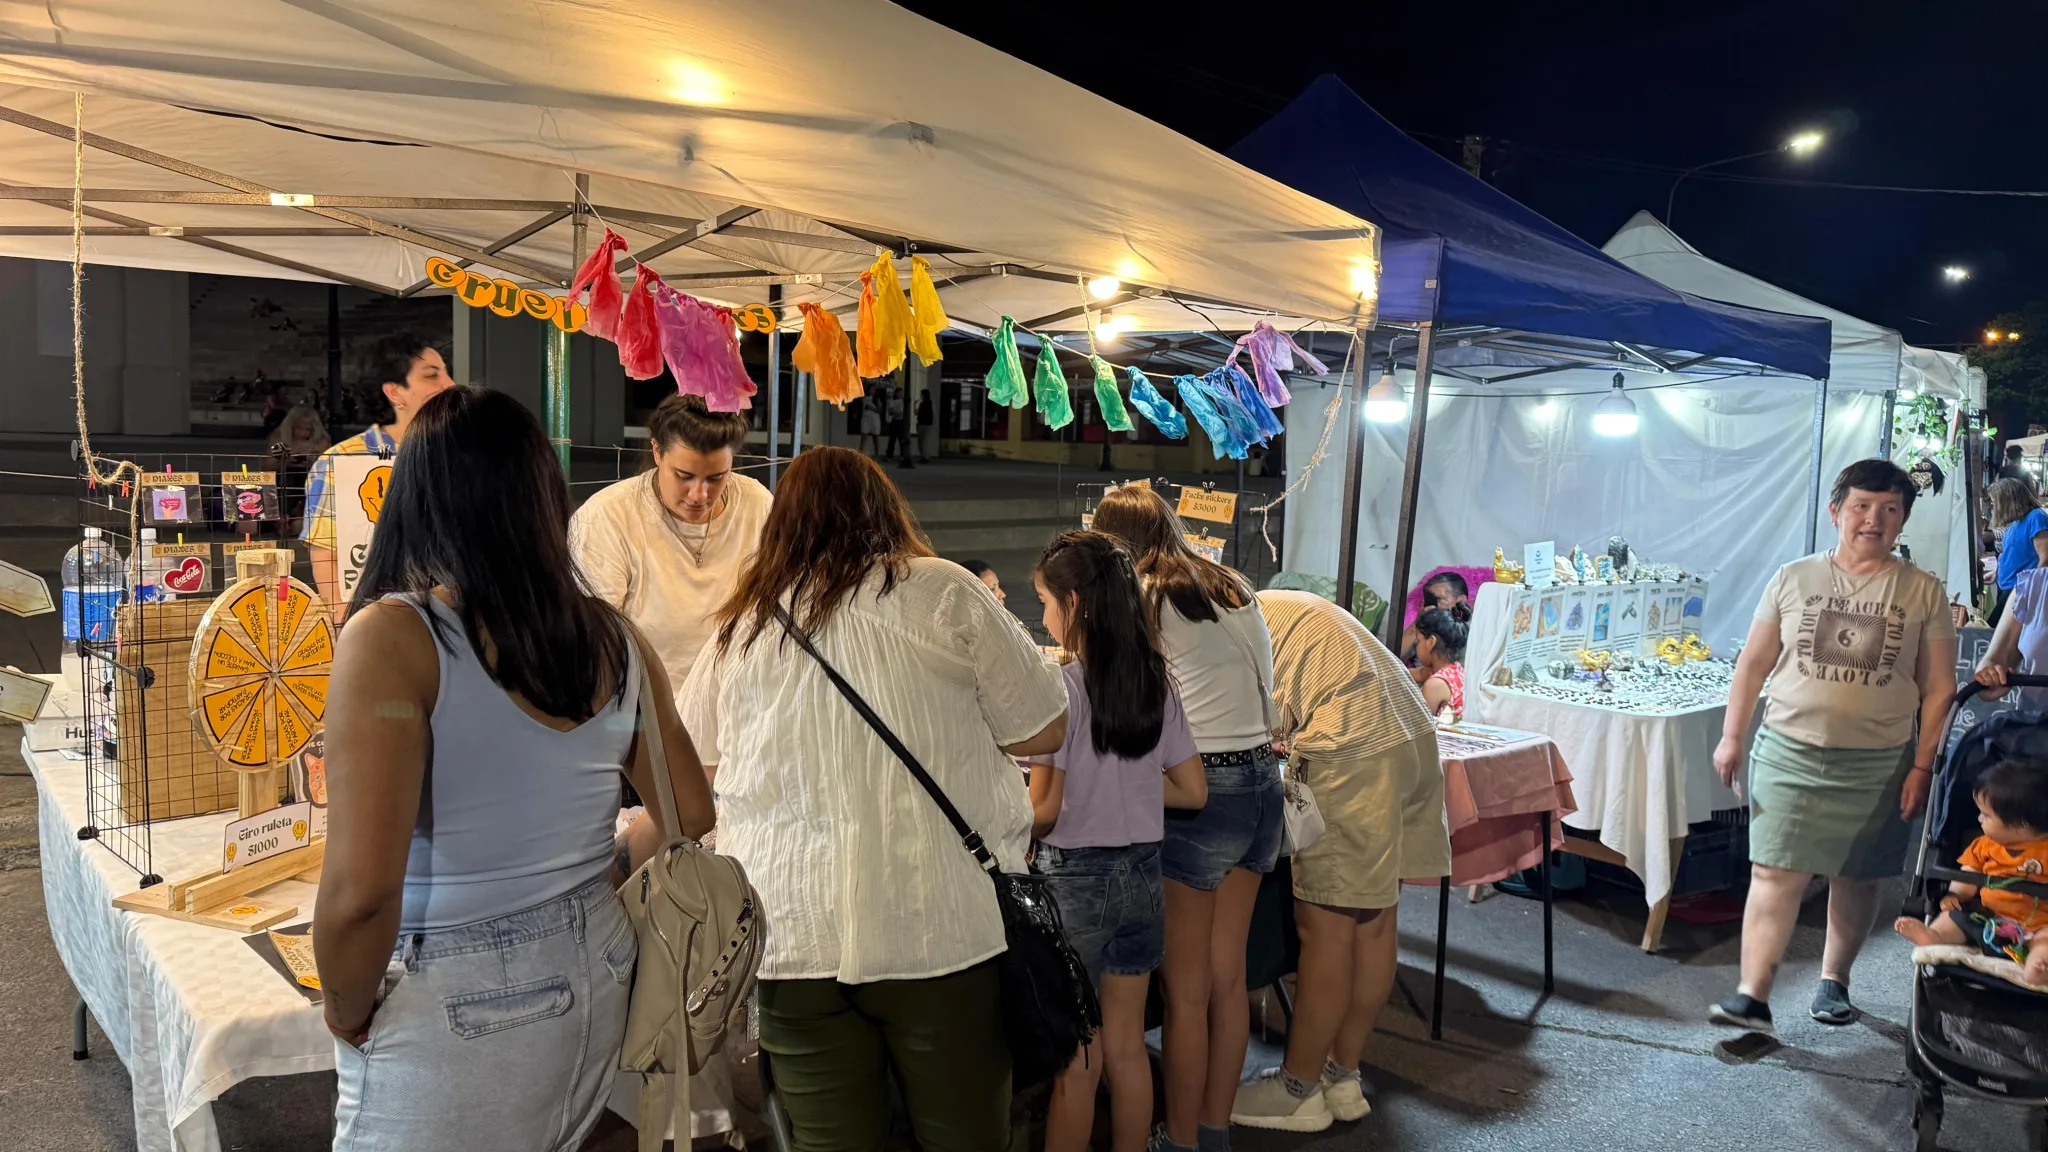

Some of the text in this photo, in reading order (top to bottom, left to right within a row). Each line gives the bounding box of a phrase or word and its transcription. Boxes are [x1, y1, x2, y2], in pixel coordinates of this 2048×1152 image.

[1184, 490, 1232, 504] Packs stickers
[1826, 597, 1885, 616] PEACE
[1816, 664, 1871, 685] LOVE
[238, 817, 292, 841] Giro ruleta
[247, 836, 279, 856] $1000
